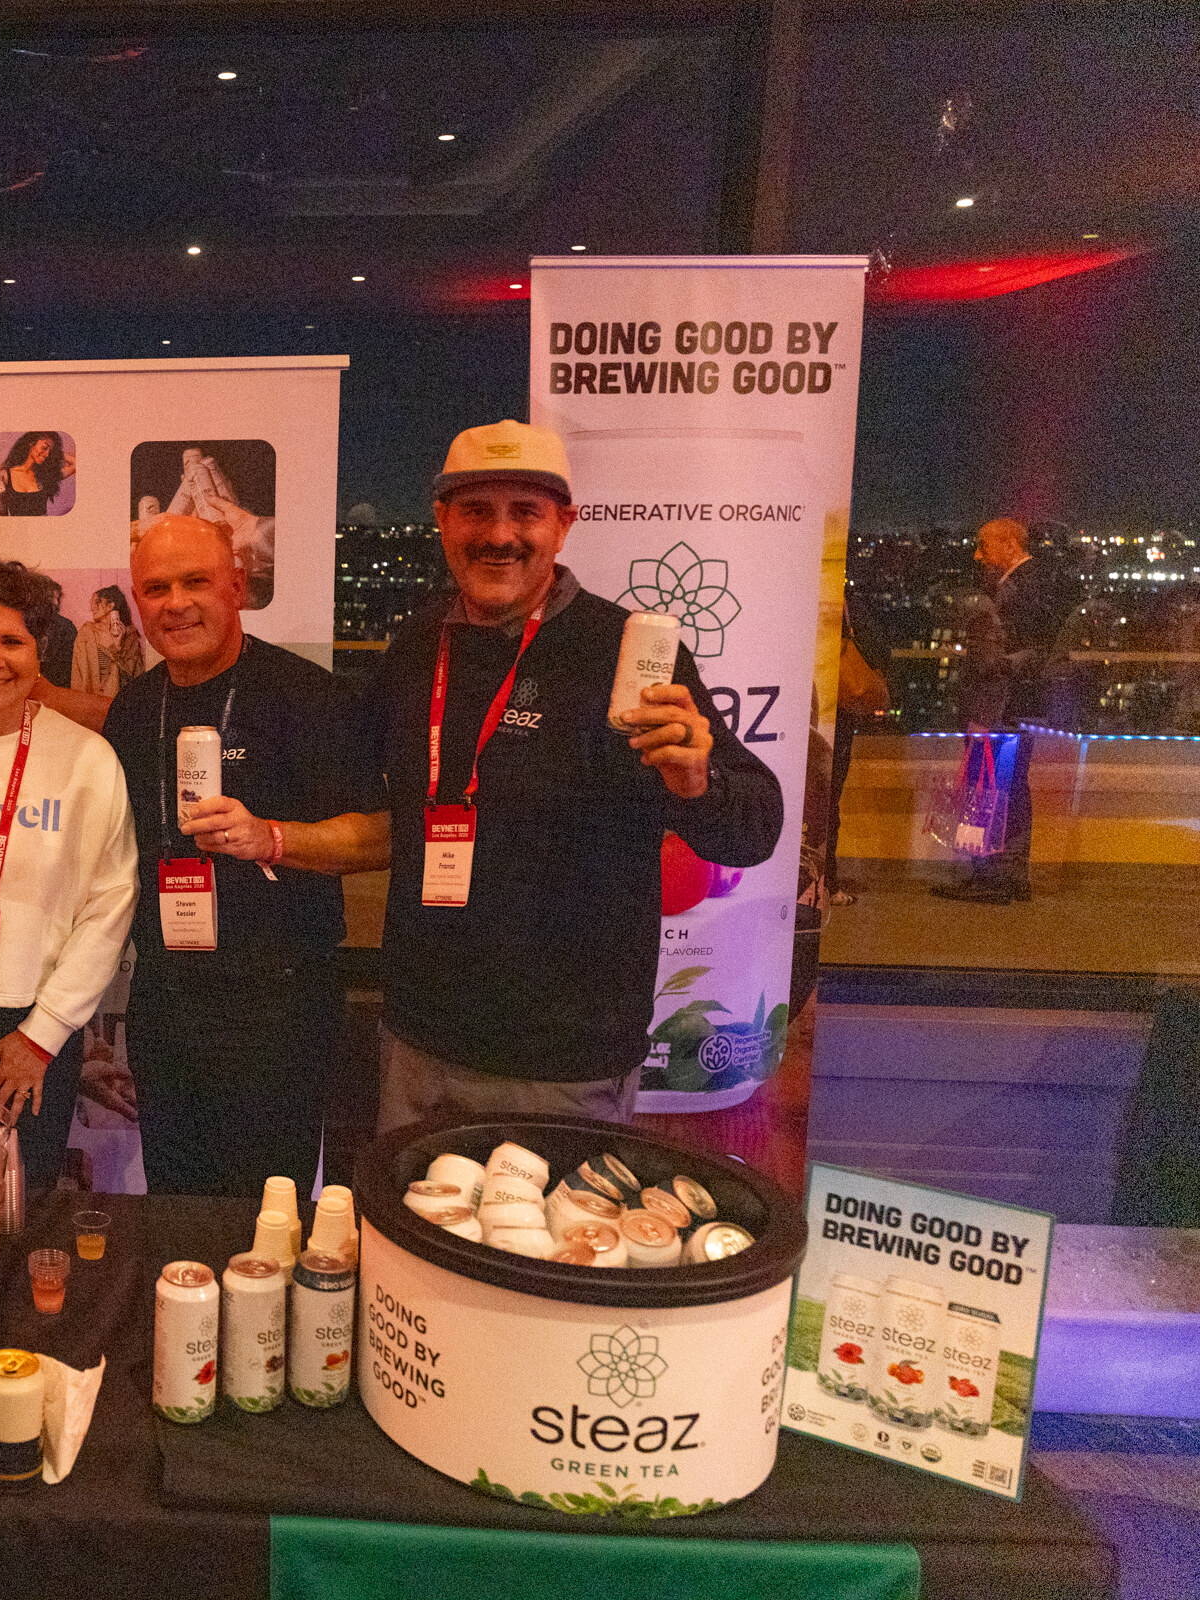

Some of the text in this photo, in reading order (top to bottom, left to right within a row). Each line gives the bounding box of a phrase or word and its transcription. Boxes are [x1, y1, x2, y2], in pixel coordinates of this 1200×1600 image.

[550, 321, 838, 356] DOING GOOD BY
[550, 361, 719, 395] BREWING
[719, 504, 802, 522] ORGANIC
[499, 709, 543, 729] eaz
[221, 748, 246, 761] eaz
[430, 725, 440, 766] BEVNET
[178, 769, 208, 780] steaz
[432, 824, 458, 833] BEVNET
[165, 876, 193, 885] BEVNET
[175, 900, 196, 908] Steven
[660, 947, 714, 956] FLAVORED
[825, 1193, 1030, 1259] DOING GOOD BY
[822, 1219, 941, 1266] BREWING
[376, 1284, 427, 1335] DOING
[368, 1303, 441, 1367] GOOD BY
[830, 1314, 875, 1338] steaz
[881, 1326, 937, 1354] steaz
[369, 1328, 446, 1398] BREWING
[942, 1346, 992, 1370] steaz
[530, 1404, 702, 1454] steaz
[550, 1457, 679, 1478] GREEN TEA
